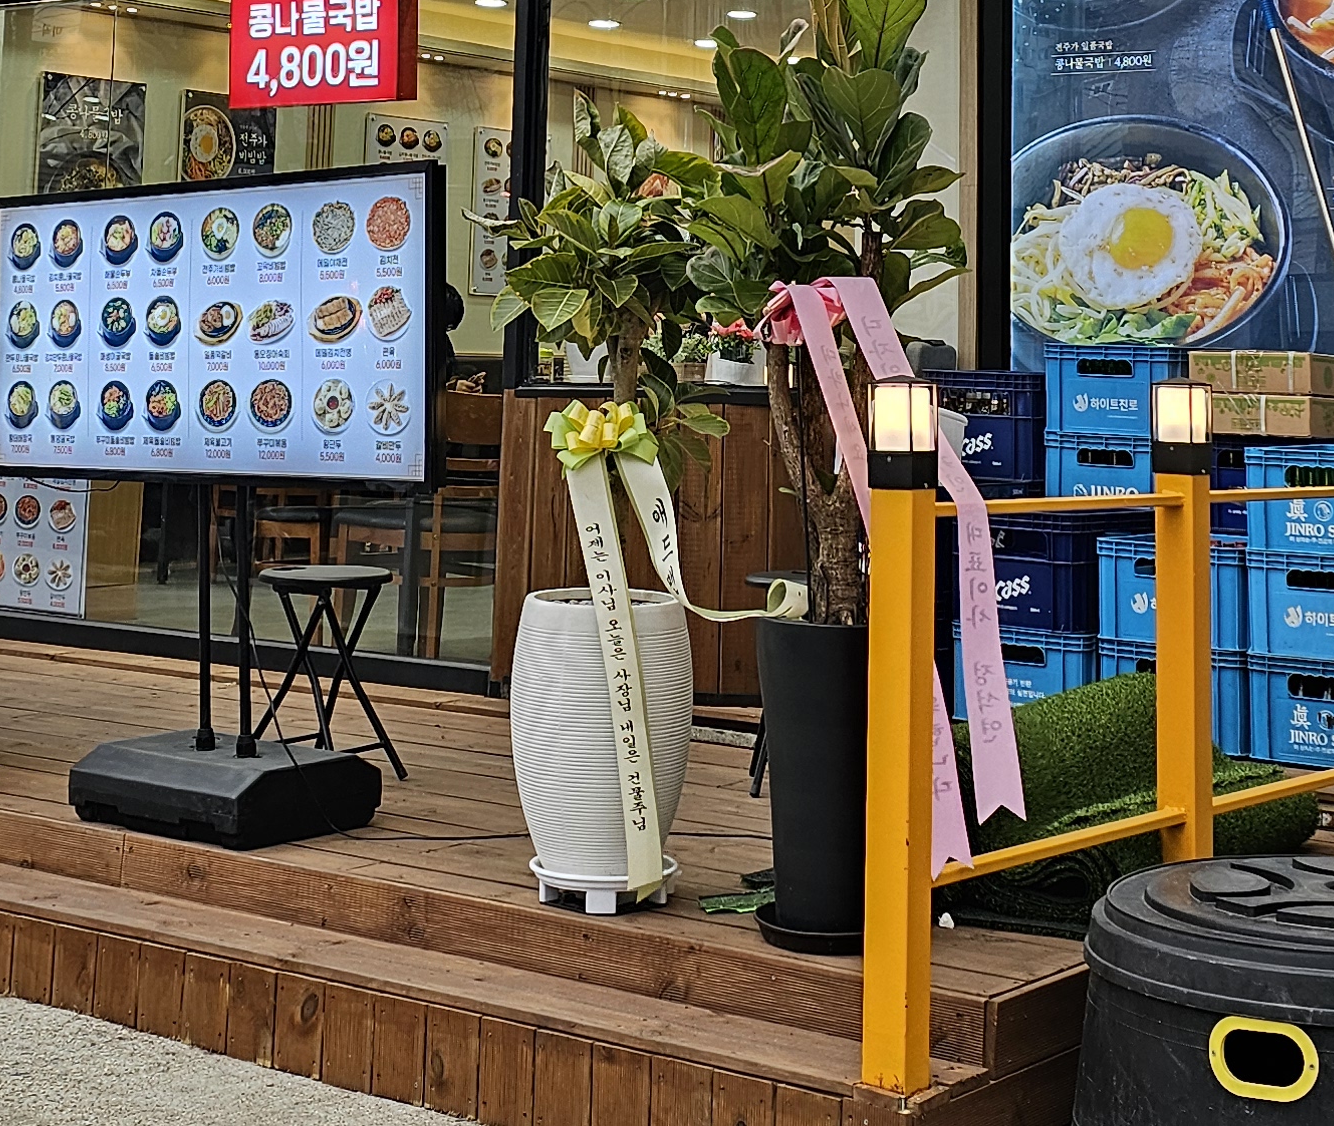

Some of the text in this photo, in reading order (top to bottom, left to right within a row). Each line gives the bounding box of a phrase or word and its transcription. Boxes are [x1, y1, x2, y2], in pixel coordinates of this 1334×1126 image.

[1054, 53, 1152, 70] 콩나물국밥 4,800원
[246, 42, 379, 98] 4,800원
[238, 132, 268, 149] 전주가
[238, 150, 267, 166] 비빔밥
[379, 254, 400, 266] 김치전
[319, 269, 346, 281] 5,500원
[375, 266, 403, 278] 5,500원
[206, 361, 229, 372] 7,000원
[257, 360, 286, 372] 10,000원
[320, 359, 346, 371] 6,000원
[375, 358, 402, 370] 6,000원
[1089, 397, 1139, 412] 하이트진로
[204, 448, 232, 460] 12,000원
[257, 449, 286, 461] 12,000원
[319, 450, 345, 463] 5,500원
[375, 452, 402, 464] 4,000원
[1284, 522, 1325, 539] JINRO
[585, 521, 648, 832] 어제는 이사님 오늘은 사장님 내일은 건물주님
[1288, 729, 1329, 747] JINRO
